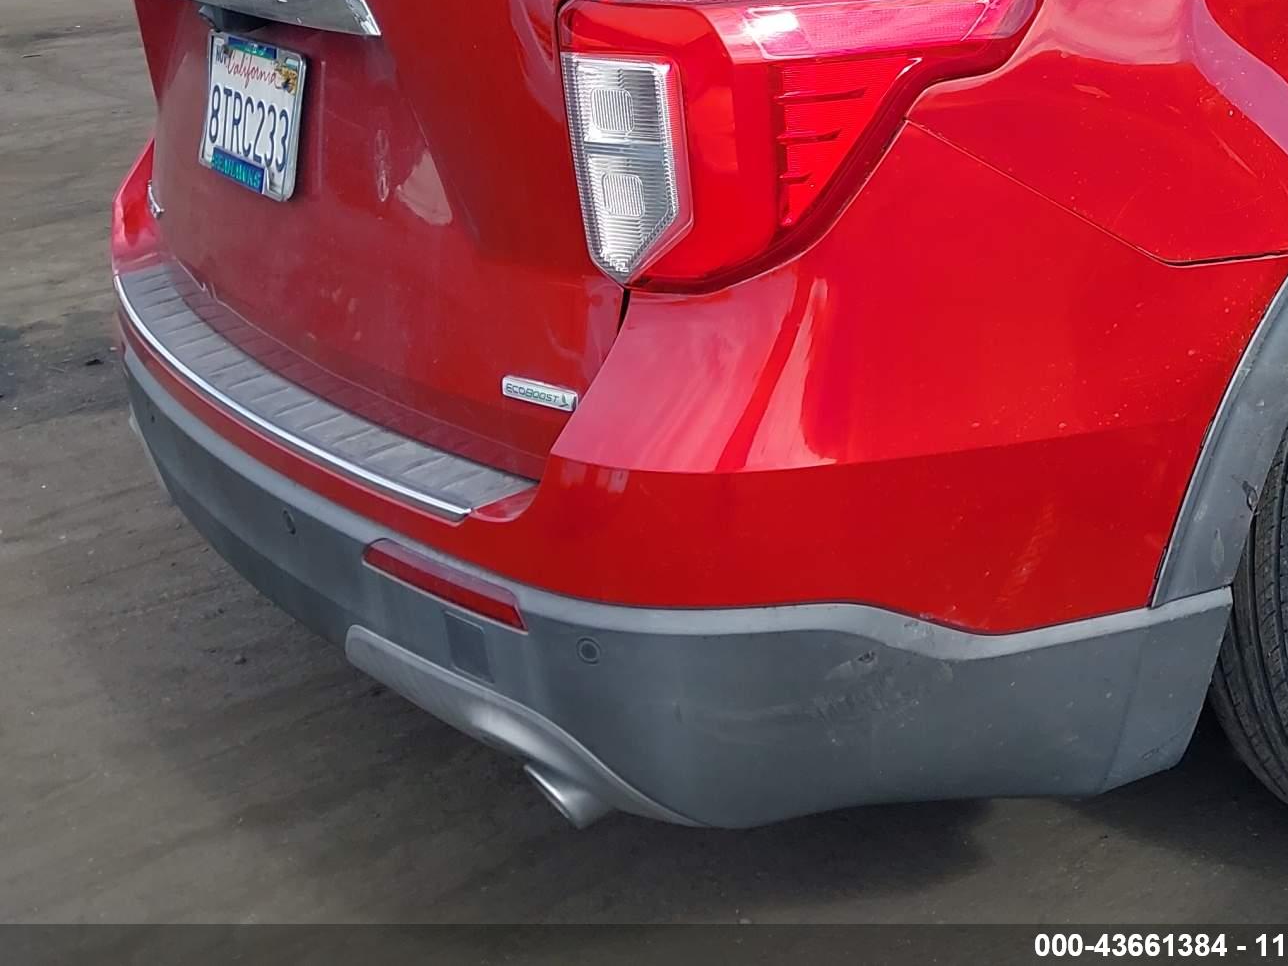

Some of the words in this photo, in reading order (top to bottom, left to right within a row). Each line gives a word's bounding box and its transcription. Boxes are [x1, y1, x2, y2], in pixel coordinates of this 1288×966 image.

[226, 50, 280, 89] California
[208, 85, 290, 173] 8TRC233
[505, 382, 560, 403] ECOBOOST
